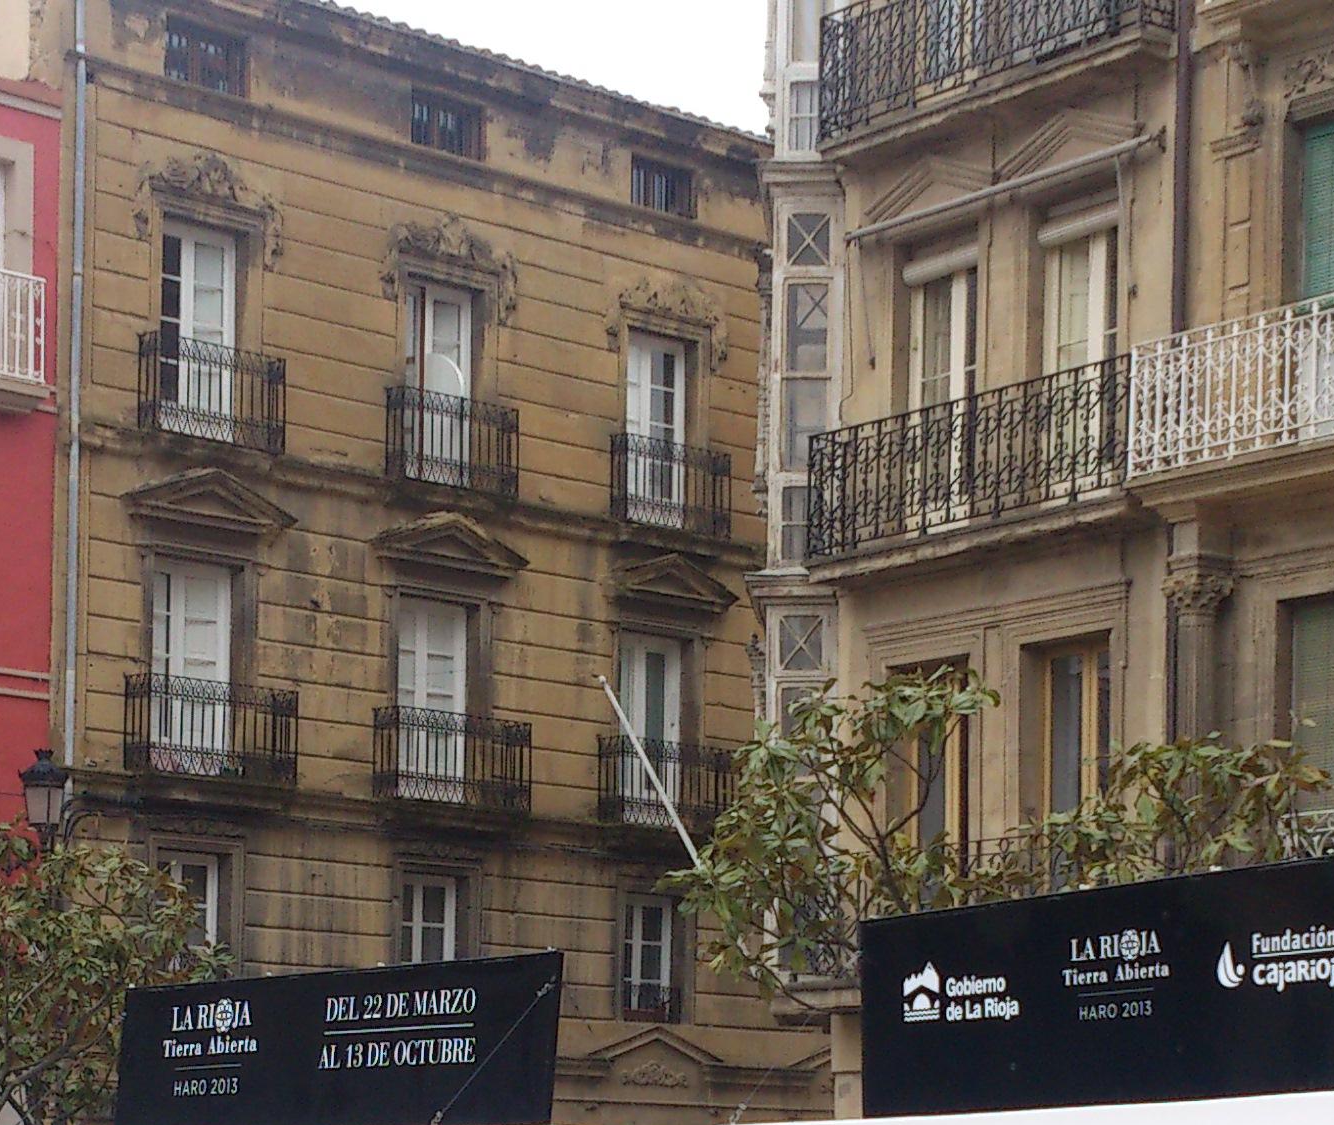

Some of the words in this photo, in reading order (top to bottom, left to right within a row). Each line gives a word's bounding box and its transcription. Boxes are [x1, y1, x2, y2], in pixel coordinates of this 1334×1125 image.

[1070, 937, 1094, 962] LA
[945, 975, 1006, 997] Gobierno
[1062, 969, 1108, 987] Tierra
[1114, 962, 1169, 983] Abierta
[325, 997, 360, 1022] DEL
[363, 995, 383, 1019] 22
[385, 992, 410, 1018] DE
[413, 987, 477, 1017] MARZO
[945, 1002, 963, 1022] de
[966, 1000, 982, 1020] La
[984, 996, 1020, 1021] Rioja
[1079, 1003, 1117, 1021] HARO
[1122, 1000, 1152, 1019] 2013
[171, 1005, 193, 1032] LA
[162, 1039, 202, 1058] Tierra
[207, 1035, 258, 1055] Abierta
[318, 1047, 341, 1070] AL
[346, 1043, 363, 1068] 13
[366, 1041, 390, 1067] DE
[394, 1037, 477, 1066] OCTUBRE
[173, 1079, 207, 1097] HARO
[210, 1077, 239, 1095] 2013
